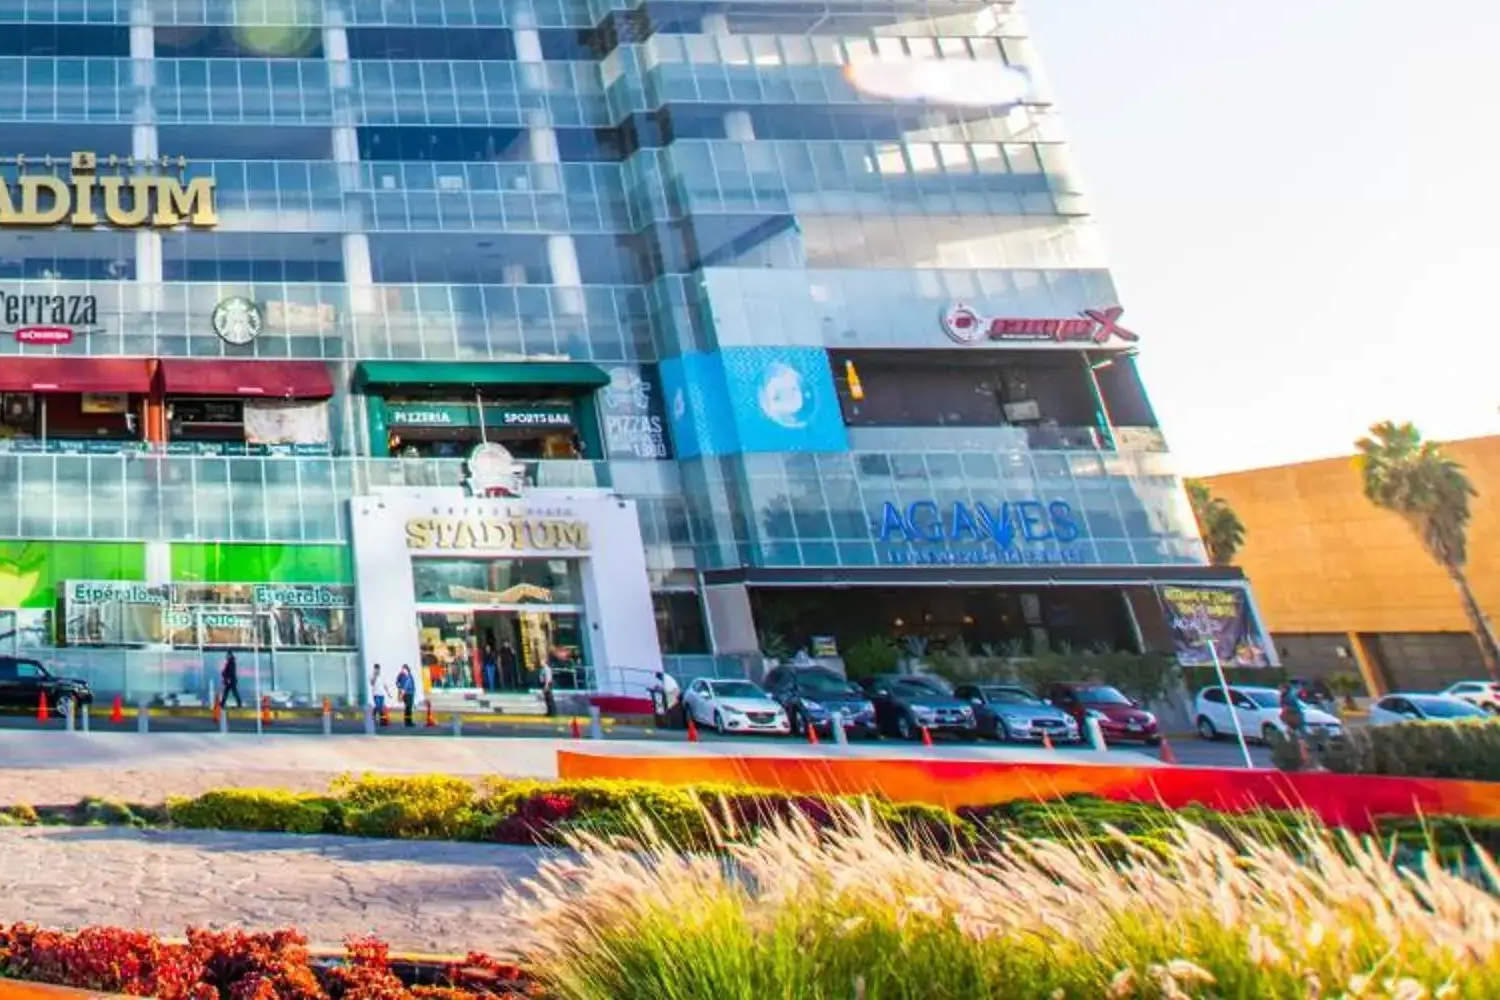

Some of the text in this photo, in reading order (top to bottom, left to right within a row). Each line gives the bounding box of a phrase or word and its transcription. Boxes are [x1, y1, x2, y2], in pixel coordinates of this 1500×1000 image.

[394, 411, 451, 424] PIZZERIA
[503, 413, 571, 424] SPORTS BAR
[405, 517, 593, 551] STADIUM
[881, 501, 1079, 549] AGAVES
